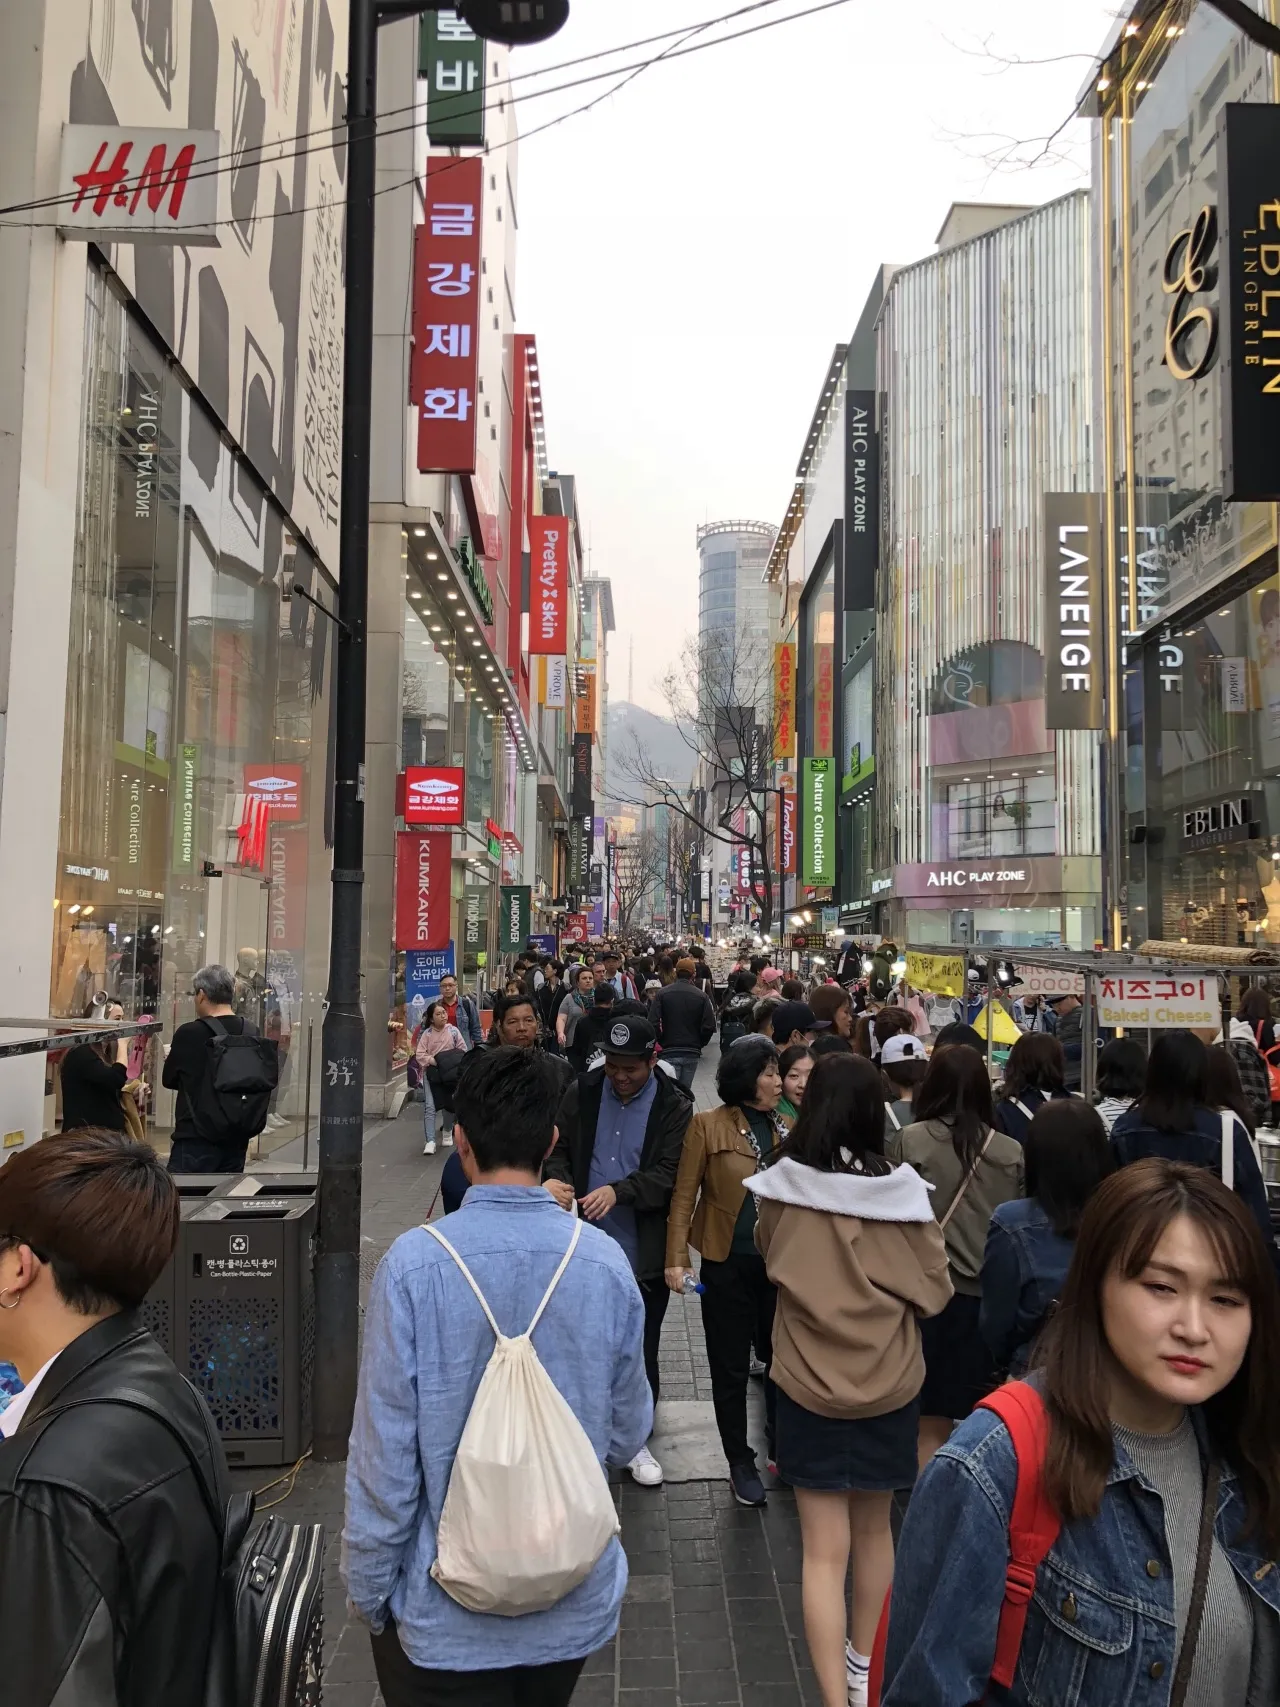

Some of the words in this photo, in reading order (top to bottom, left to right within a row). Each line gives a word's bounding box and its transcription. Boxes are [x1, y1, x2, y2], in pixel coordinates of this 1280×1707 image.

[73, 141, 196, 220] H&M
[423, 203, 475, 421] 금강제화
[1244, 229, 1260, 365] LINGERIE
[302, 316, 317, 495] FASHION
[852, 407, 868, 453] AHC
[315, 399, 326, 523] AFTER
[854, 459, 866, 492] PLAY
[325, 451, 339, 529] TRY
[854, 496, 866, 532] ZONE
[540, 530, 558, 592] Pretty
[541, 602, 557, 639] skin
[1059, 526, 1091, 692] LANEIGE
[409, 795, 459, 804] 금강제화
[814, 773, 825, 812] Nature
[129, 804, 141, 864] Collection
[1183, 799, 1243, 838] EBLIN
[570, 849, 578, 881] REPUBLIC
[813, 814, 825, 873] Collection
[417, 839, 430, 941] KUMKANG
[927, 870, 967, 887] AHC
[969, 871, 994, 882] PLAY
[997, 870, 1026, 881] ZONE
[511, 895, 520, 943] LANDROVER
[416, 956, 445, 967] 도이터
[1101, 979, 1205, 1001] 치즈구이
[1103, 1008, 1150, 1022] Baked
[1155, 1008, 1212, 1023] Cheese
[325, 1060, 353, 1086] 중구
